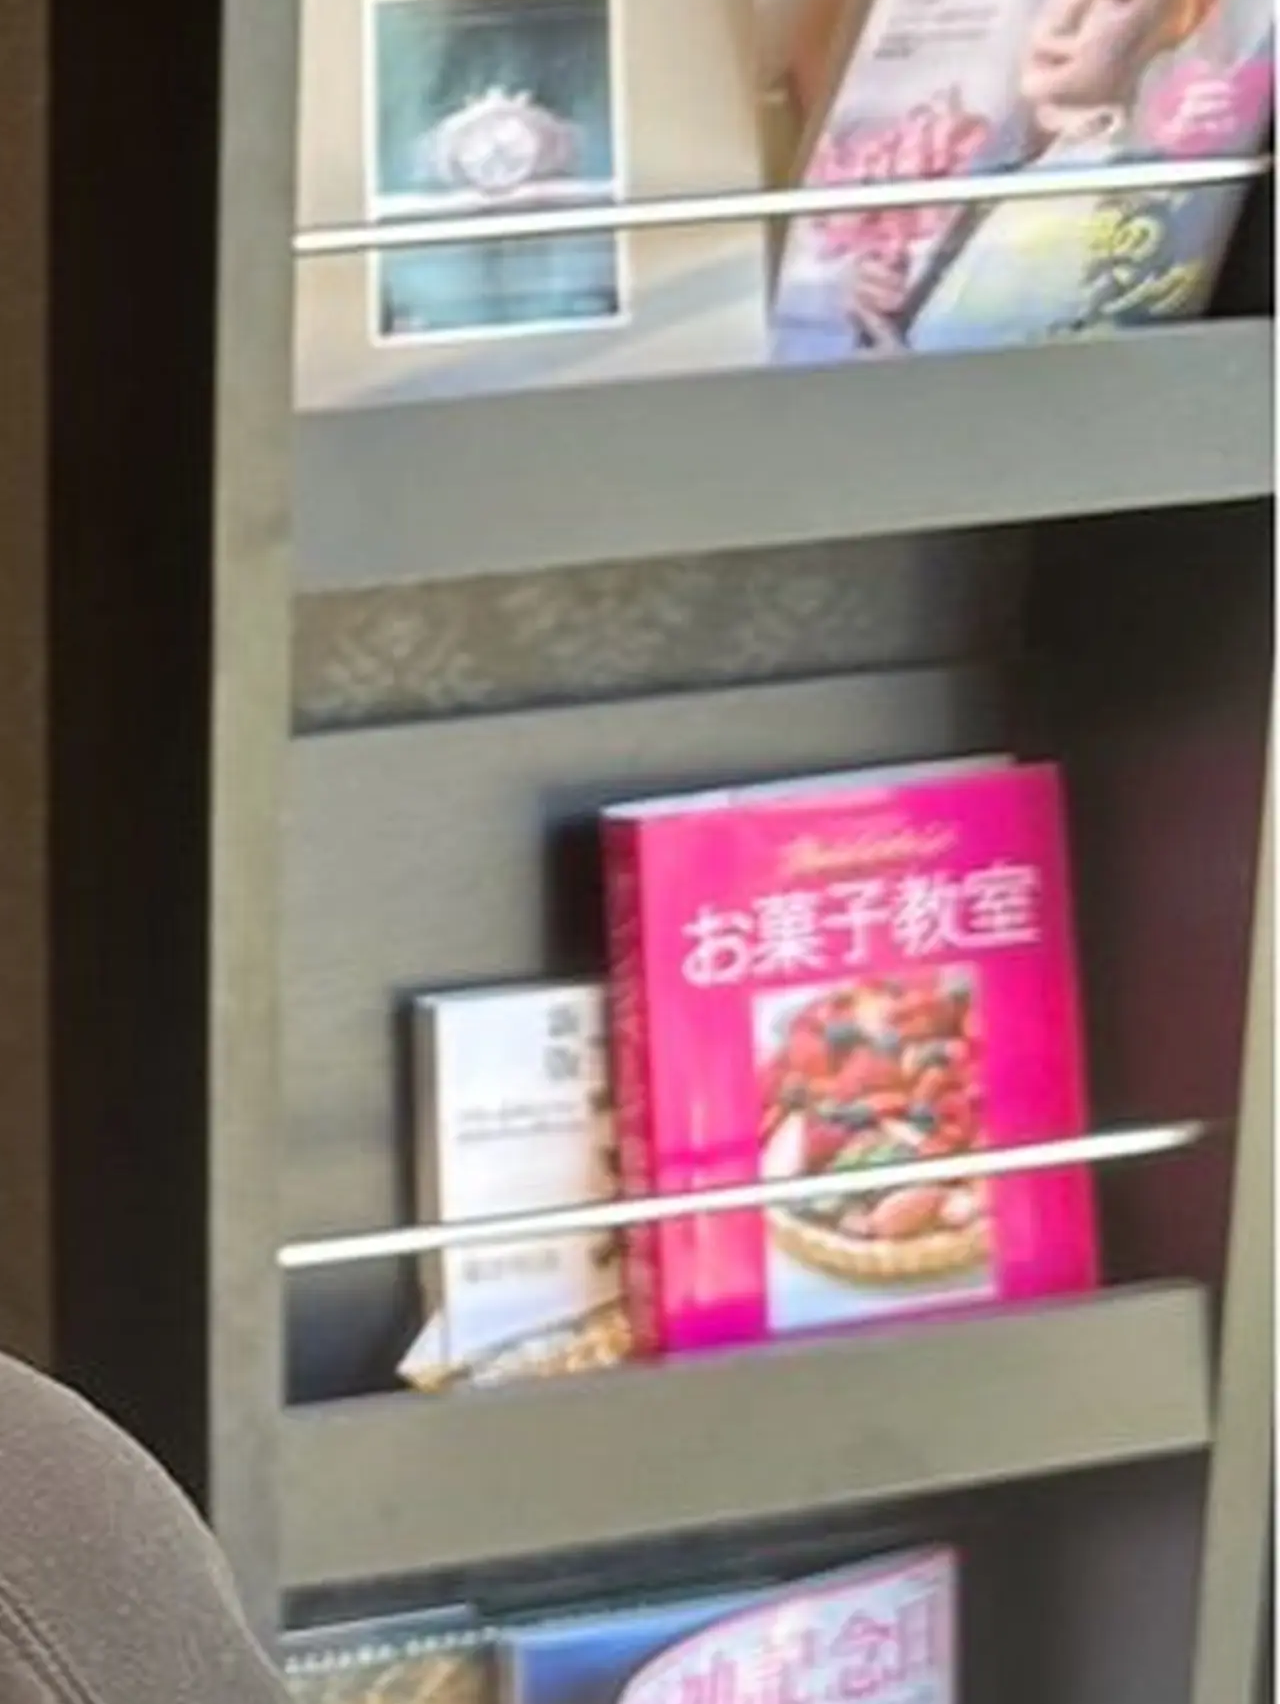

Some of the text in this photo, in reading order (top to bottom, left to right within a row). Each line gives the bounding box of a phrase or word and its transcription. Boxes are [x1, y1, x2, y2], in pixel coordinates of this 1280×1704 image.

[681, 856, 1044, 988] お菓子教室
